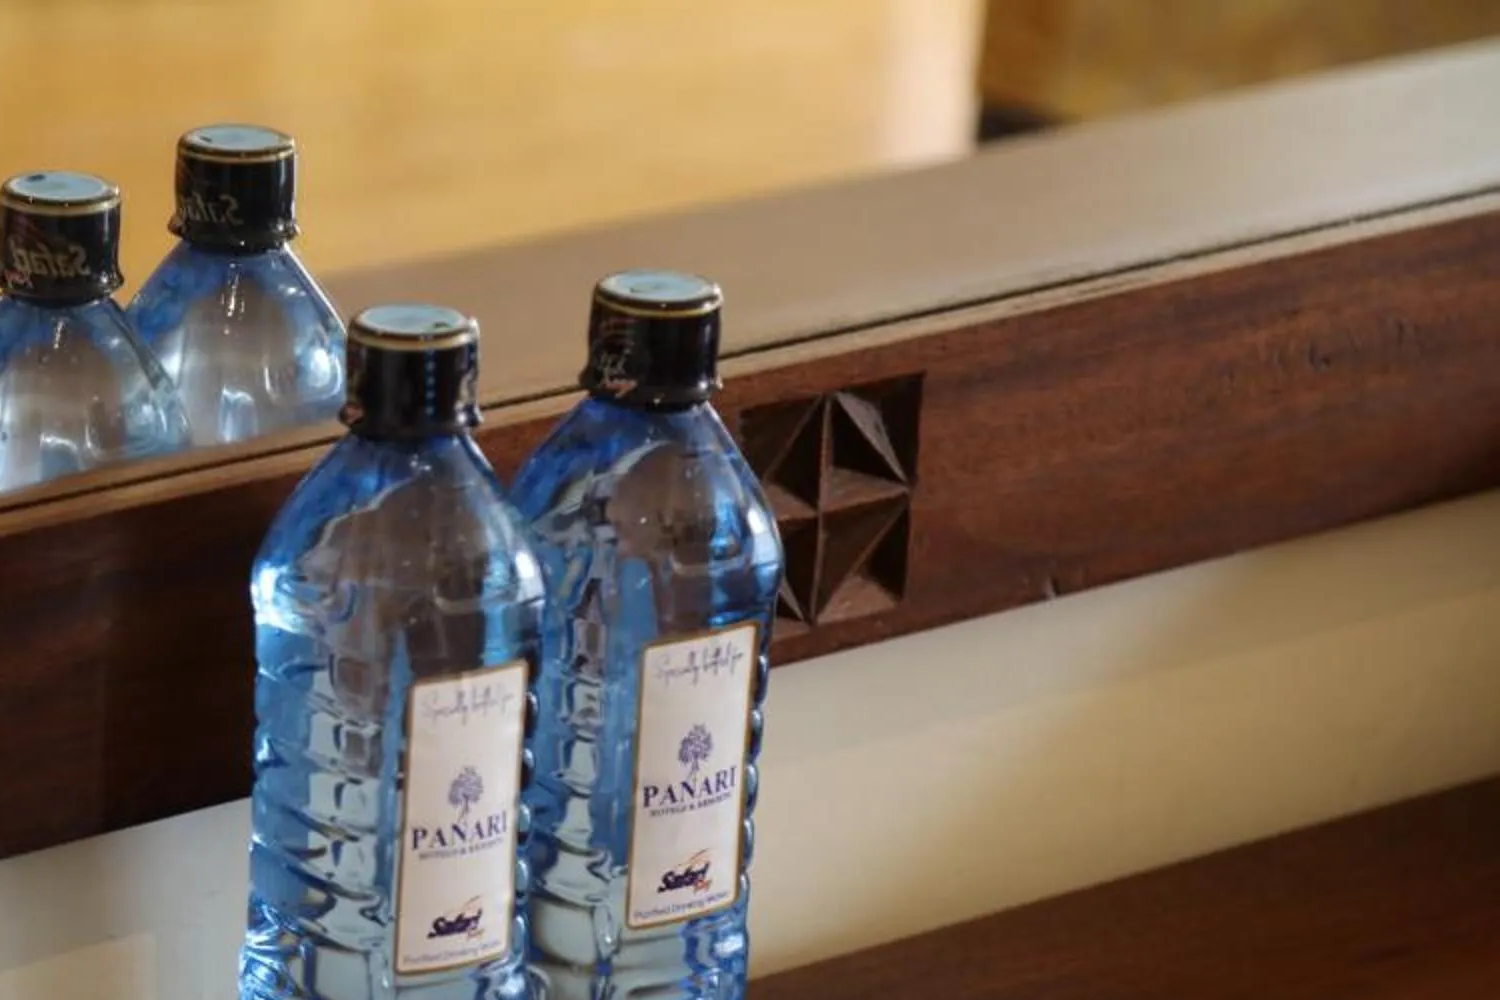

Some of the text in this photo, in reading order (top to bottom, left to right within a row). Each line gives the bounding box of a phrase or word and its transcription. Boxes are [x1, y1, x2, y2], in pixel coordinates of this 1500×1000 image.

[643, 765, 737, 807] PANARI
[412, 810, 507, 850] PANARI
[657, 860, 710, 893] Safari
[427, 908, 483, 939] Safari
